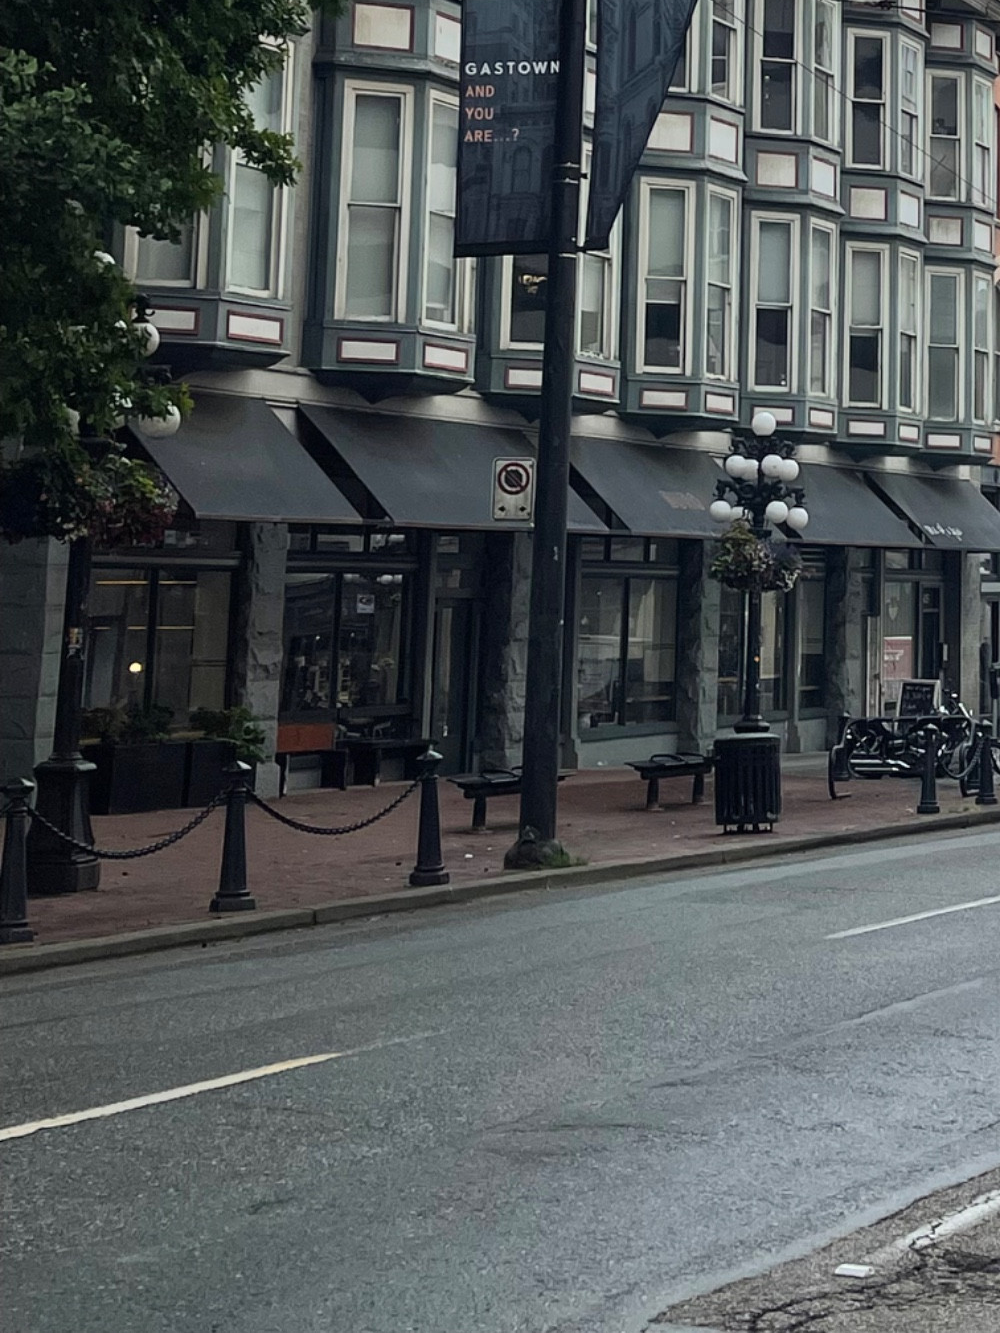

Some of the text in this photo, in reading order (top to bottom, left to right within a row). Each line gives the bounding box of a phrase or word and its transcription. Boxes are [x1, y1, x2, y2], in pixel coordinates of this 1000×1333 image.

[464, 61, 560, 75] GASTOWN
[465, 85, 495, 98] AND
[464, 107, 494, 120] YOU
